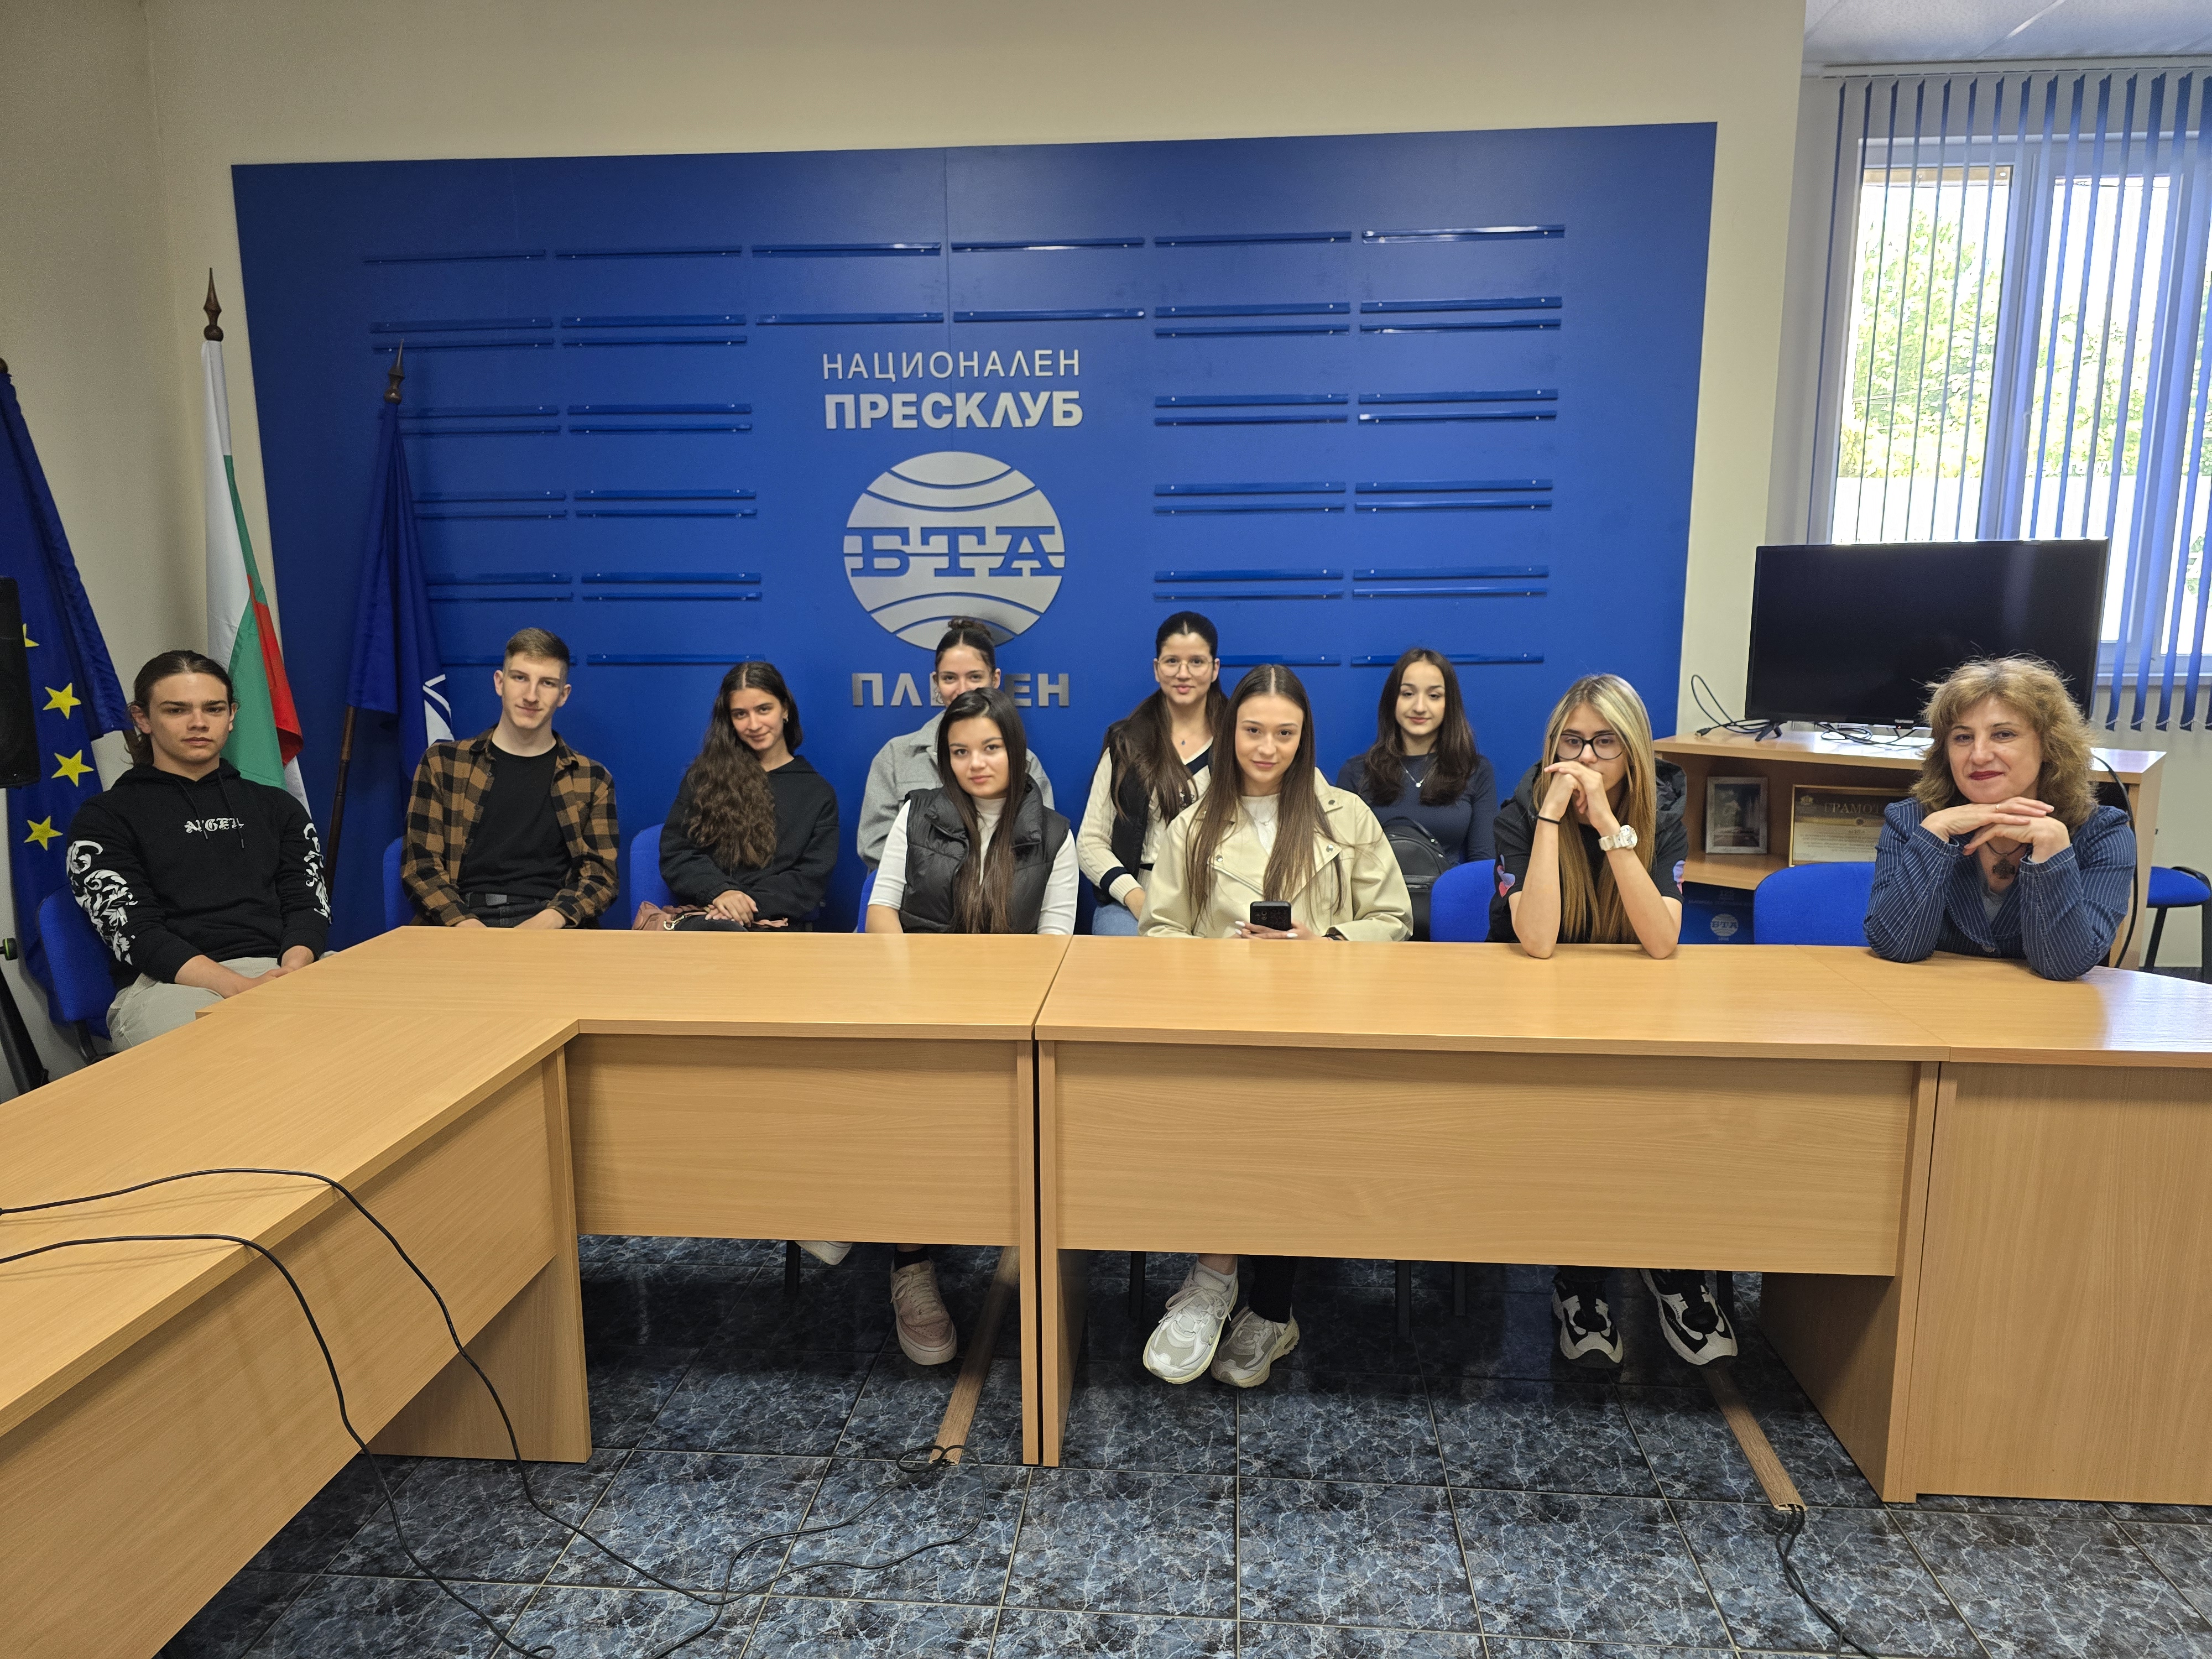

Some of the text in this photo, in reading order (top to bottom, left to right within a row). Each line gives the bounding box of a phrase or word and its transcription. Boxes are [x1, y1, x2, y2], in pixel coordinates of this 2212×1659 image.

[823, 349, 1079, 382] НАЦИОНАЛЕН
[825, 390, 1084, 429] ПРЕСКЛУБ
[846, 526, 1057, 577] БТА
[852, 672, 1070, 707] ПЛЕН
[1824, 802, 1882, 813] ГРАМОТ
